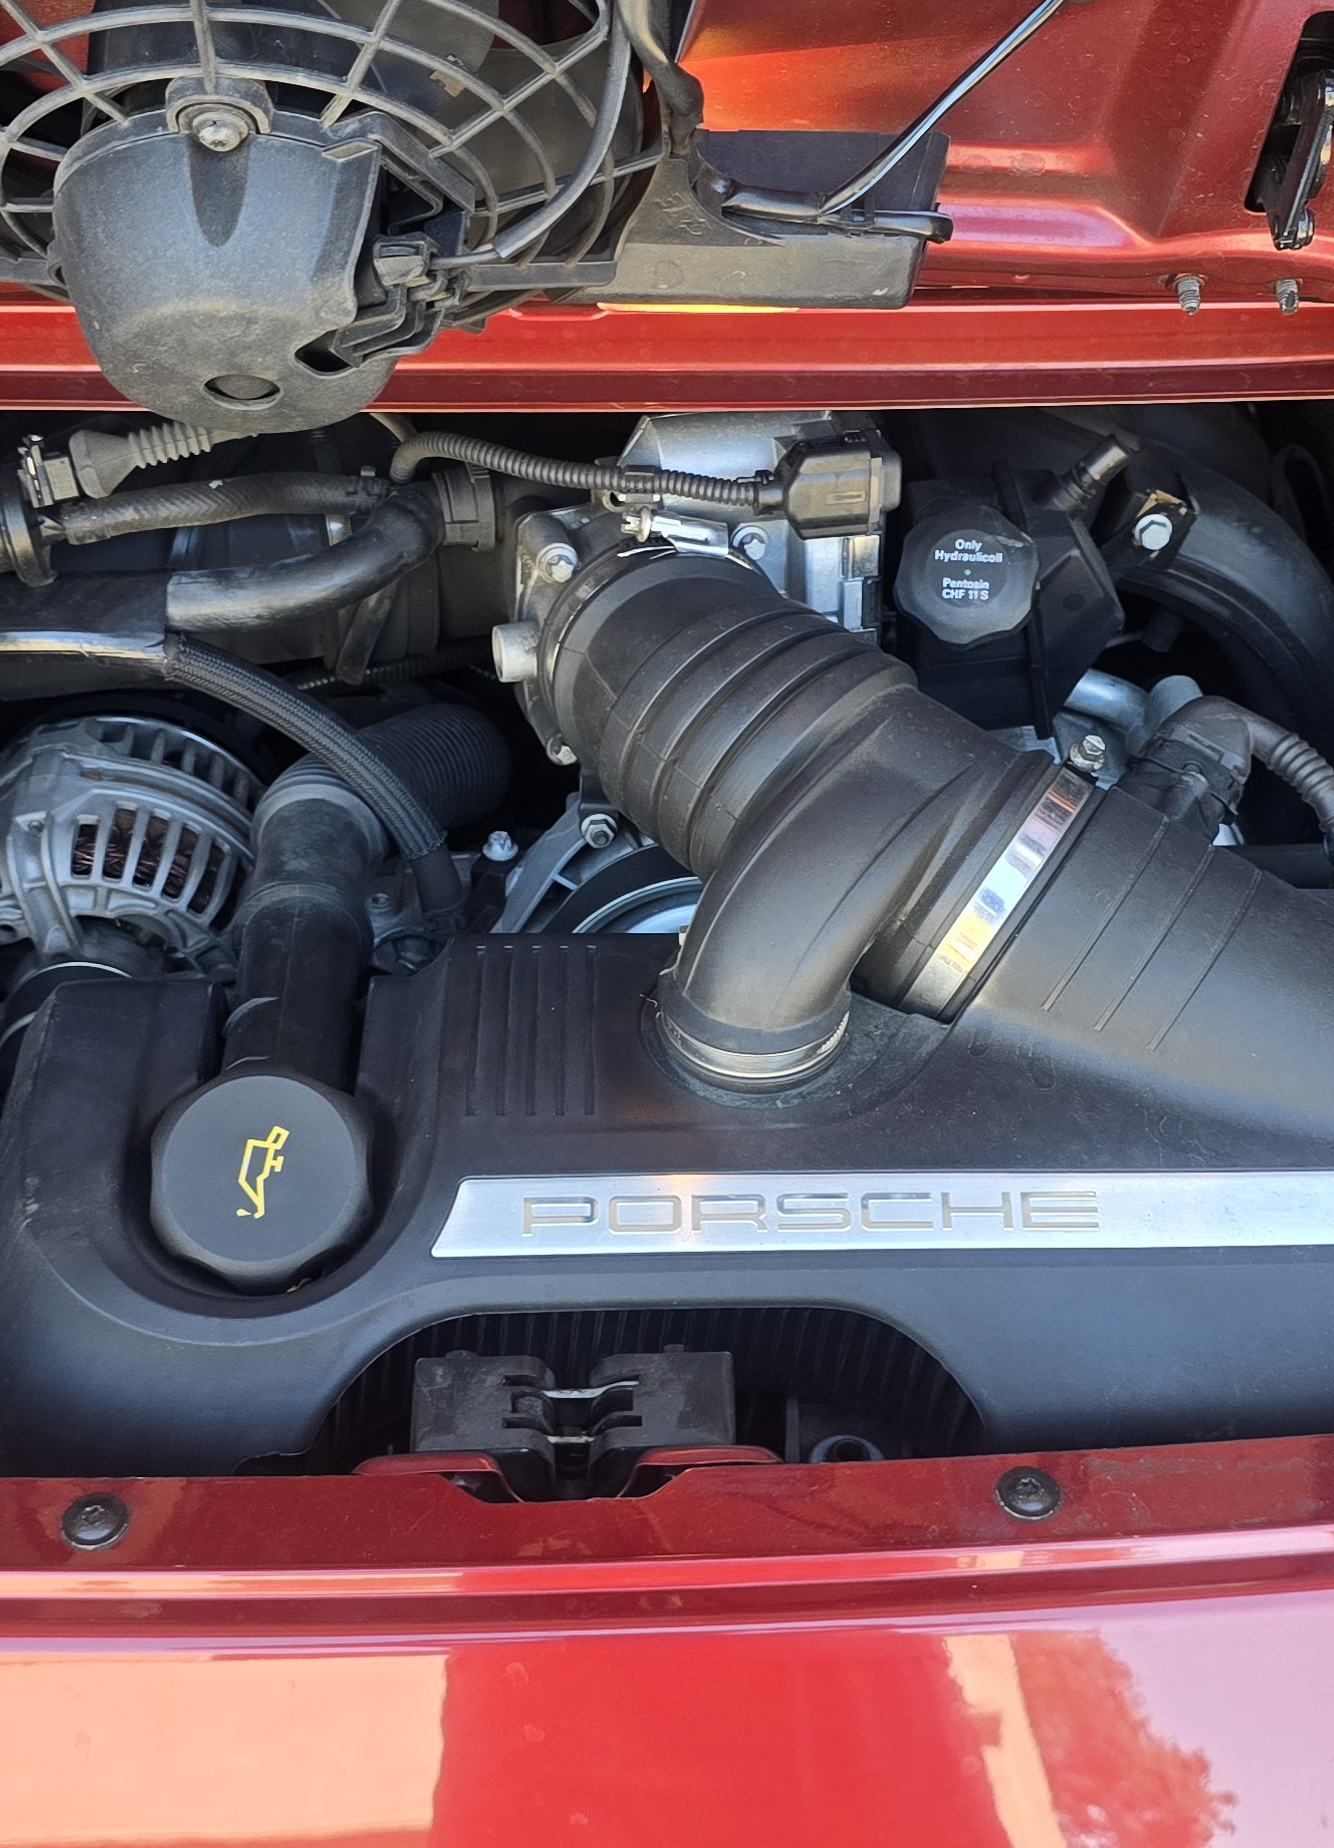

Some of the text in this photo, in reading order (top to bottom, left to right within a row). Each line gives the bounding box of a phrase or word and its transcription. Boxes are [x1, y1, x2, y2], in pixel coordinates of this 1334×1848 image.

[954, 538, 983, 552] Only
[942, 577, 990, 590] Pentosin
[941, 588, 989, 600] CHF 11 S
[521, 1190, 1101, 1238] PORSCHE
